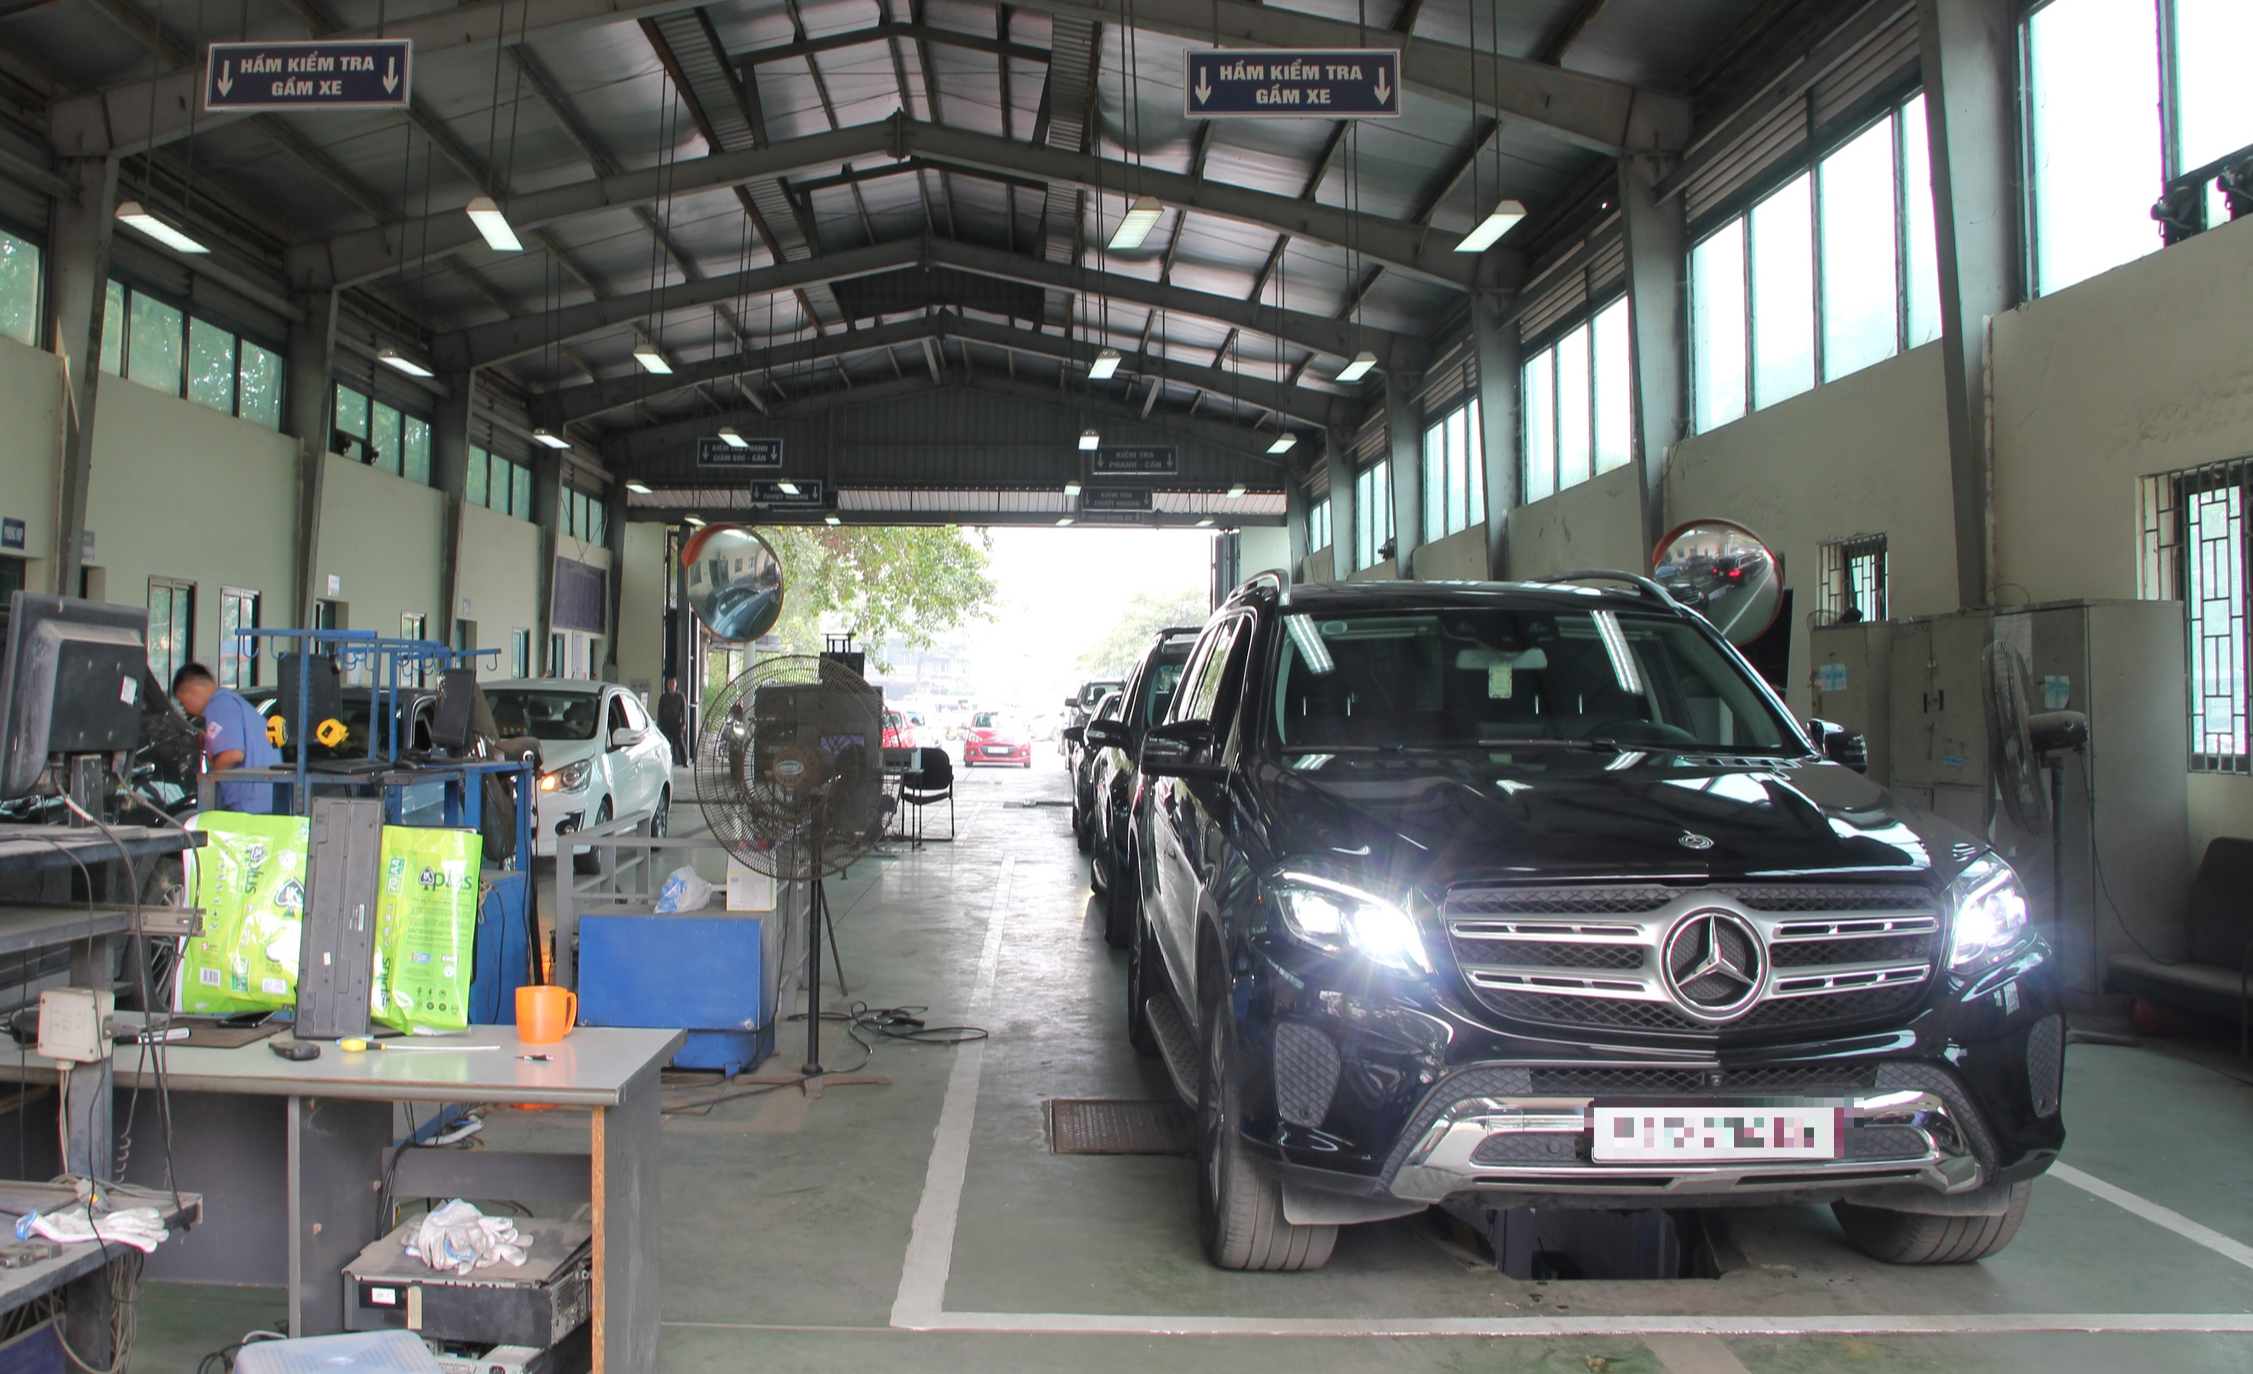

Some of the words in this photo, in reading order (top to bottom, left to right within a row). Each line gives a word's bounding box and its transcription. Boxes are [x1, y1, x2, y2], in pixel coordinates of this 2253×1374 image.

[287, 51, 335, 72] KIỂM
[340, 56, 375, 71] TRA
[1270, 58, 1320, 81] KIỂM
[1326, 65, 1363, 81] TRA
[318, 81, 343, 95] XE
[1306, 89, 1331, 104] XE
[432, 869, 472, 892] pls
